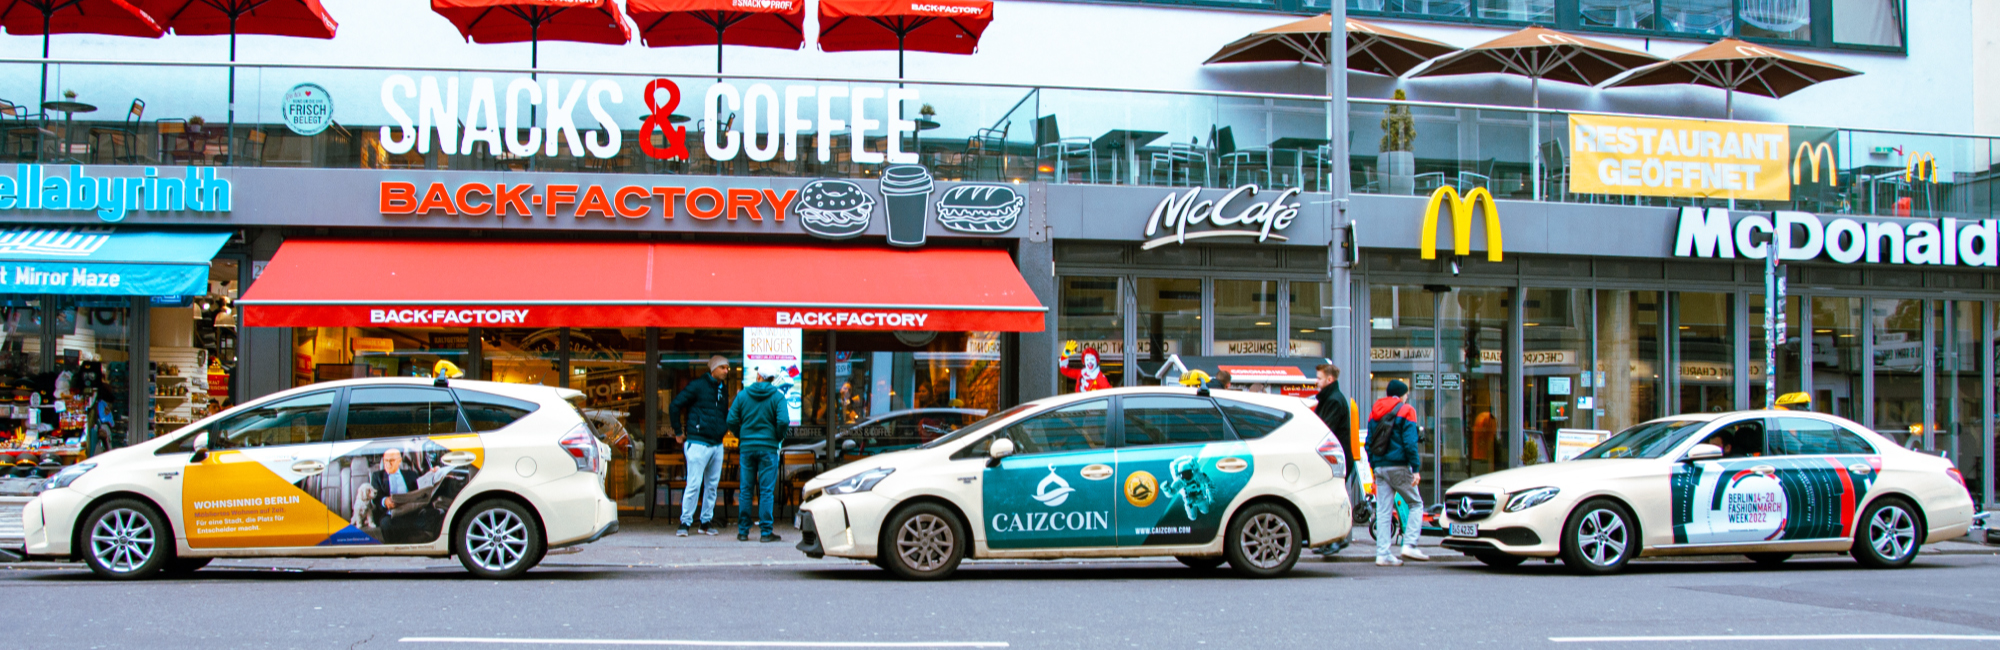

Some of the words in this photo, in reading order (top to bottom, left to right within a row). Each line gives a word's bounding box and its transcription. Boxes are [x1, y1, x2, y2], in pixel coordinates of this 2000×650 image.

[289, 104, 326, 115] FRISCH
[294, 116, 322, 124] BELEGT
[380, 74, 623, 159] SNACKS
[638, 77, 689, 160] &
[705, 82, 920, 164] COFFEE
[1575, 125, 1783, 160] RESTAURANT
[1598, 158, 1761, 190] GEÖFFNET
[0, 163, 232, 222] ellabyrinth
[1145, 184, 1300, 245] McCafé
[15, 266, 69, 286] Mirror
[72, 267, 120, 287] Maze
[751, 338, 793, 353] BRINGER
[194, 498, 262, 509] WOHNSINNIG
[264, 495, 300, 506] BERLIN
[992, 511, 1109, 533] CAIZCOIN
[1135, 526, 1191, 535] WWW.CAIZCOIN.COM
